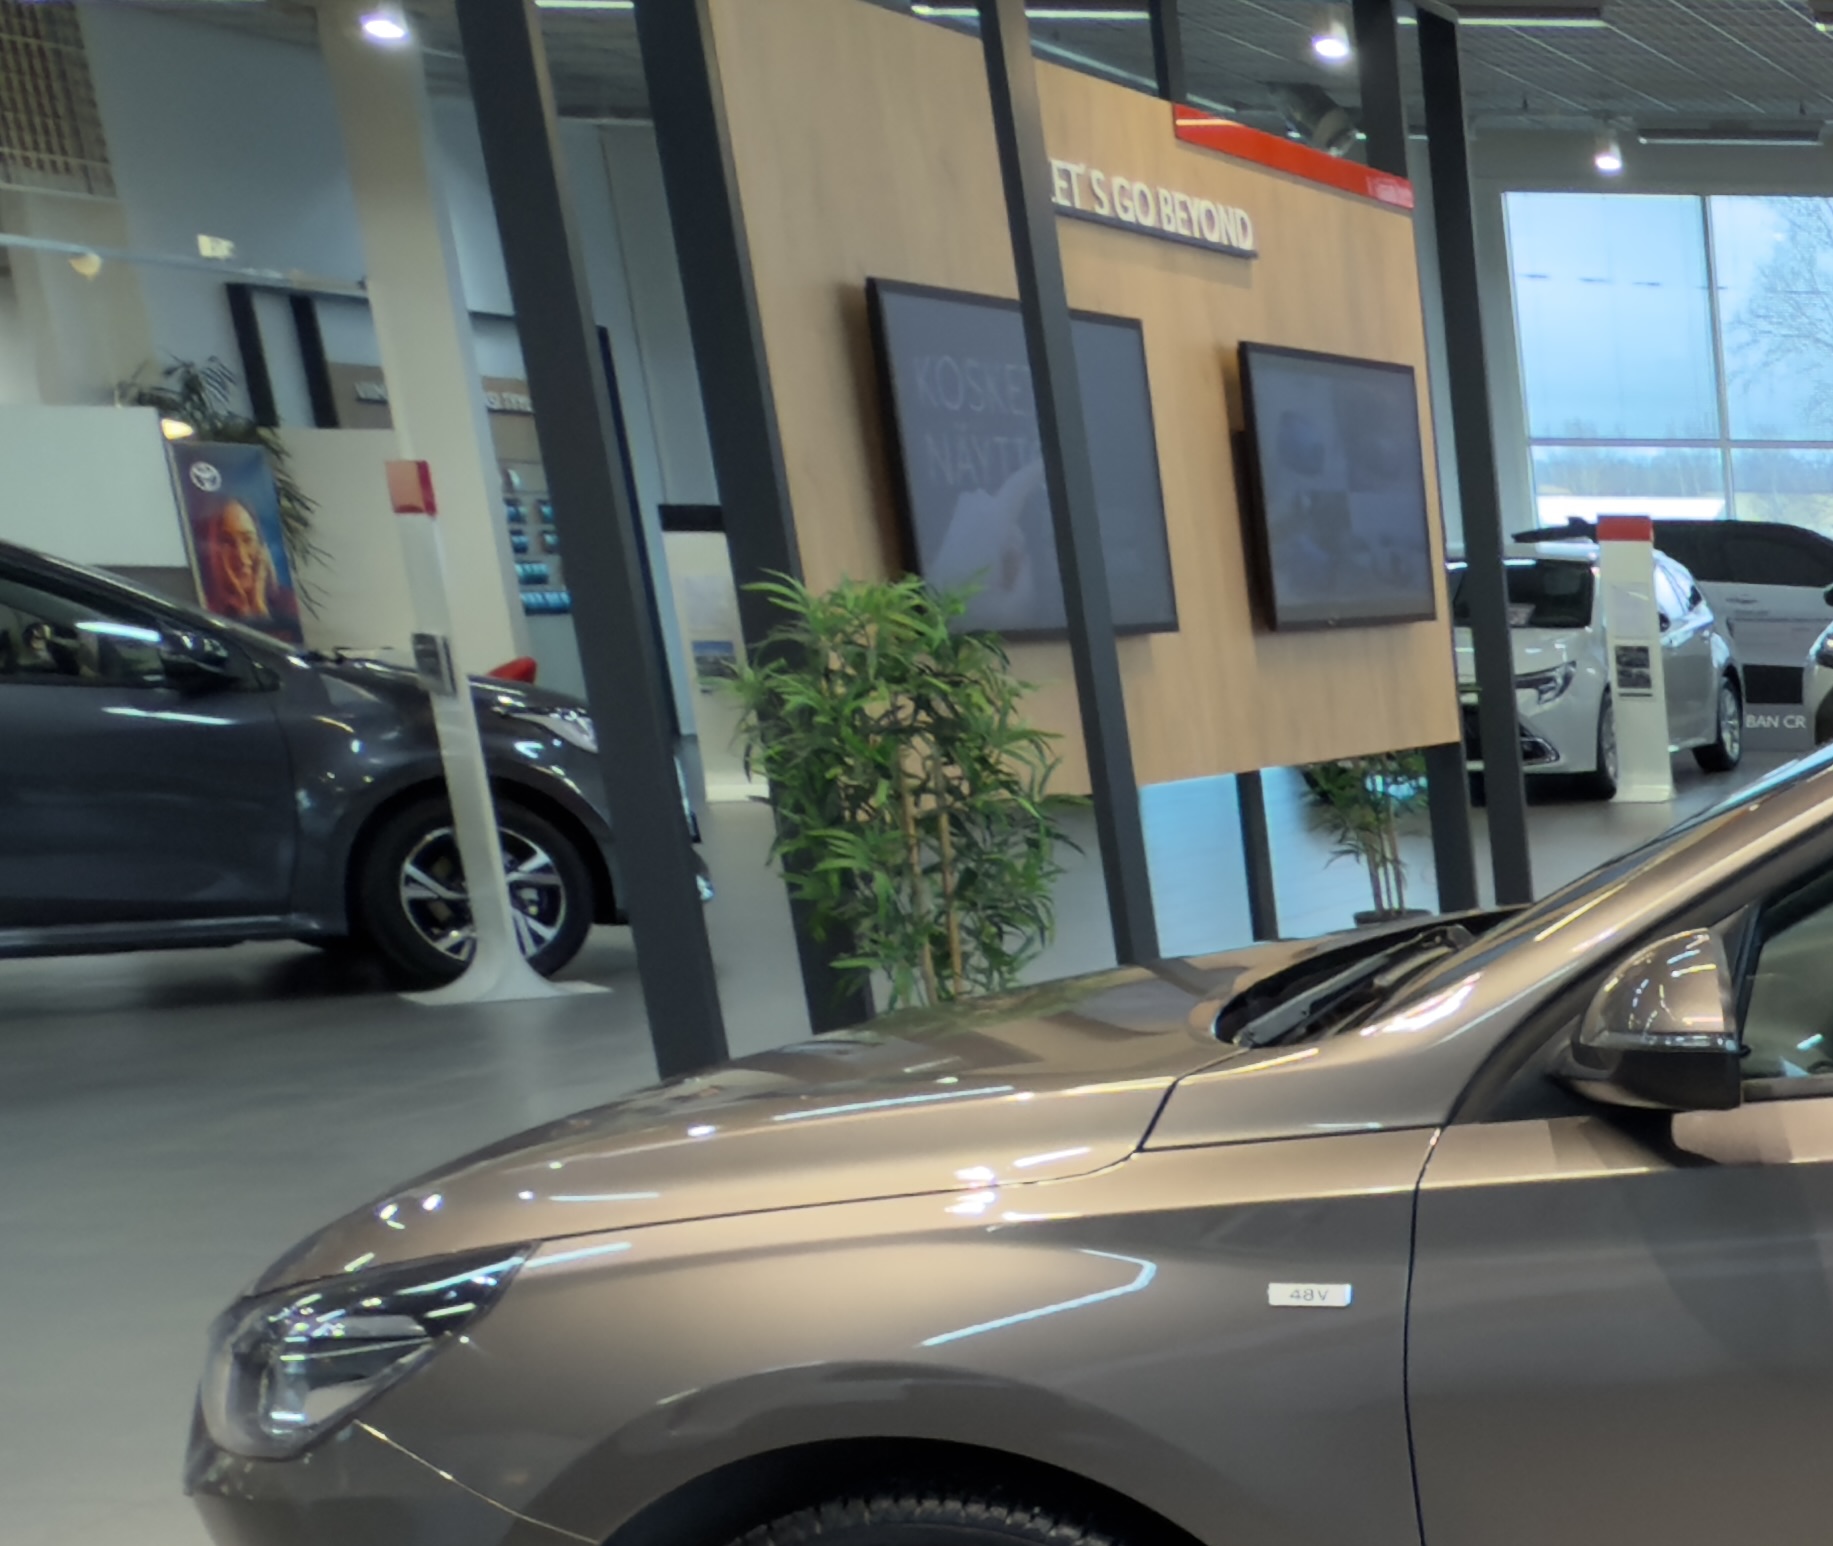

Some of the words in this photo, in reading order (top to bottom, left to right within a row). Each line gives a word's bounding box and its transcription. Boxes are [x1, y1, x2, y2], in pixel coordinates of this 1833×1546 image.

[1050, 158, 1110, 217] ET'S
[1110, 175, 1156, 228] GO
[1157, 185, 1254, 252] BEYOND
[923, 421, 1036, 486] NÄYTT
[1744, 714, 1780, 729] BAN
[1782, 714, 1807, 729] CR
